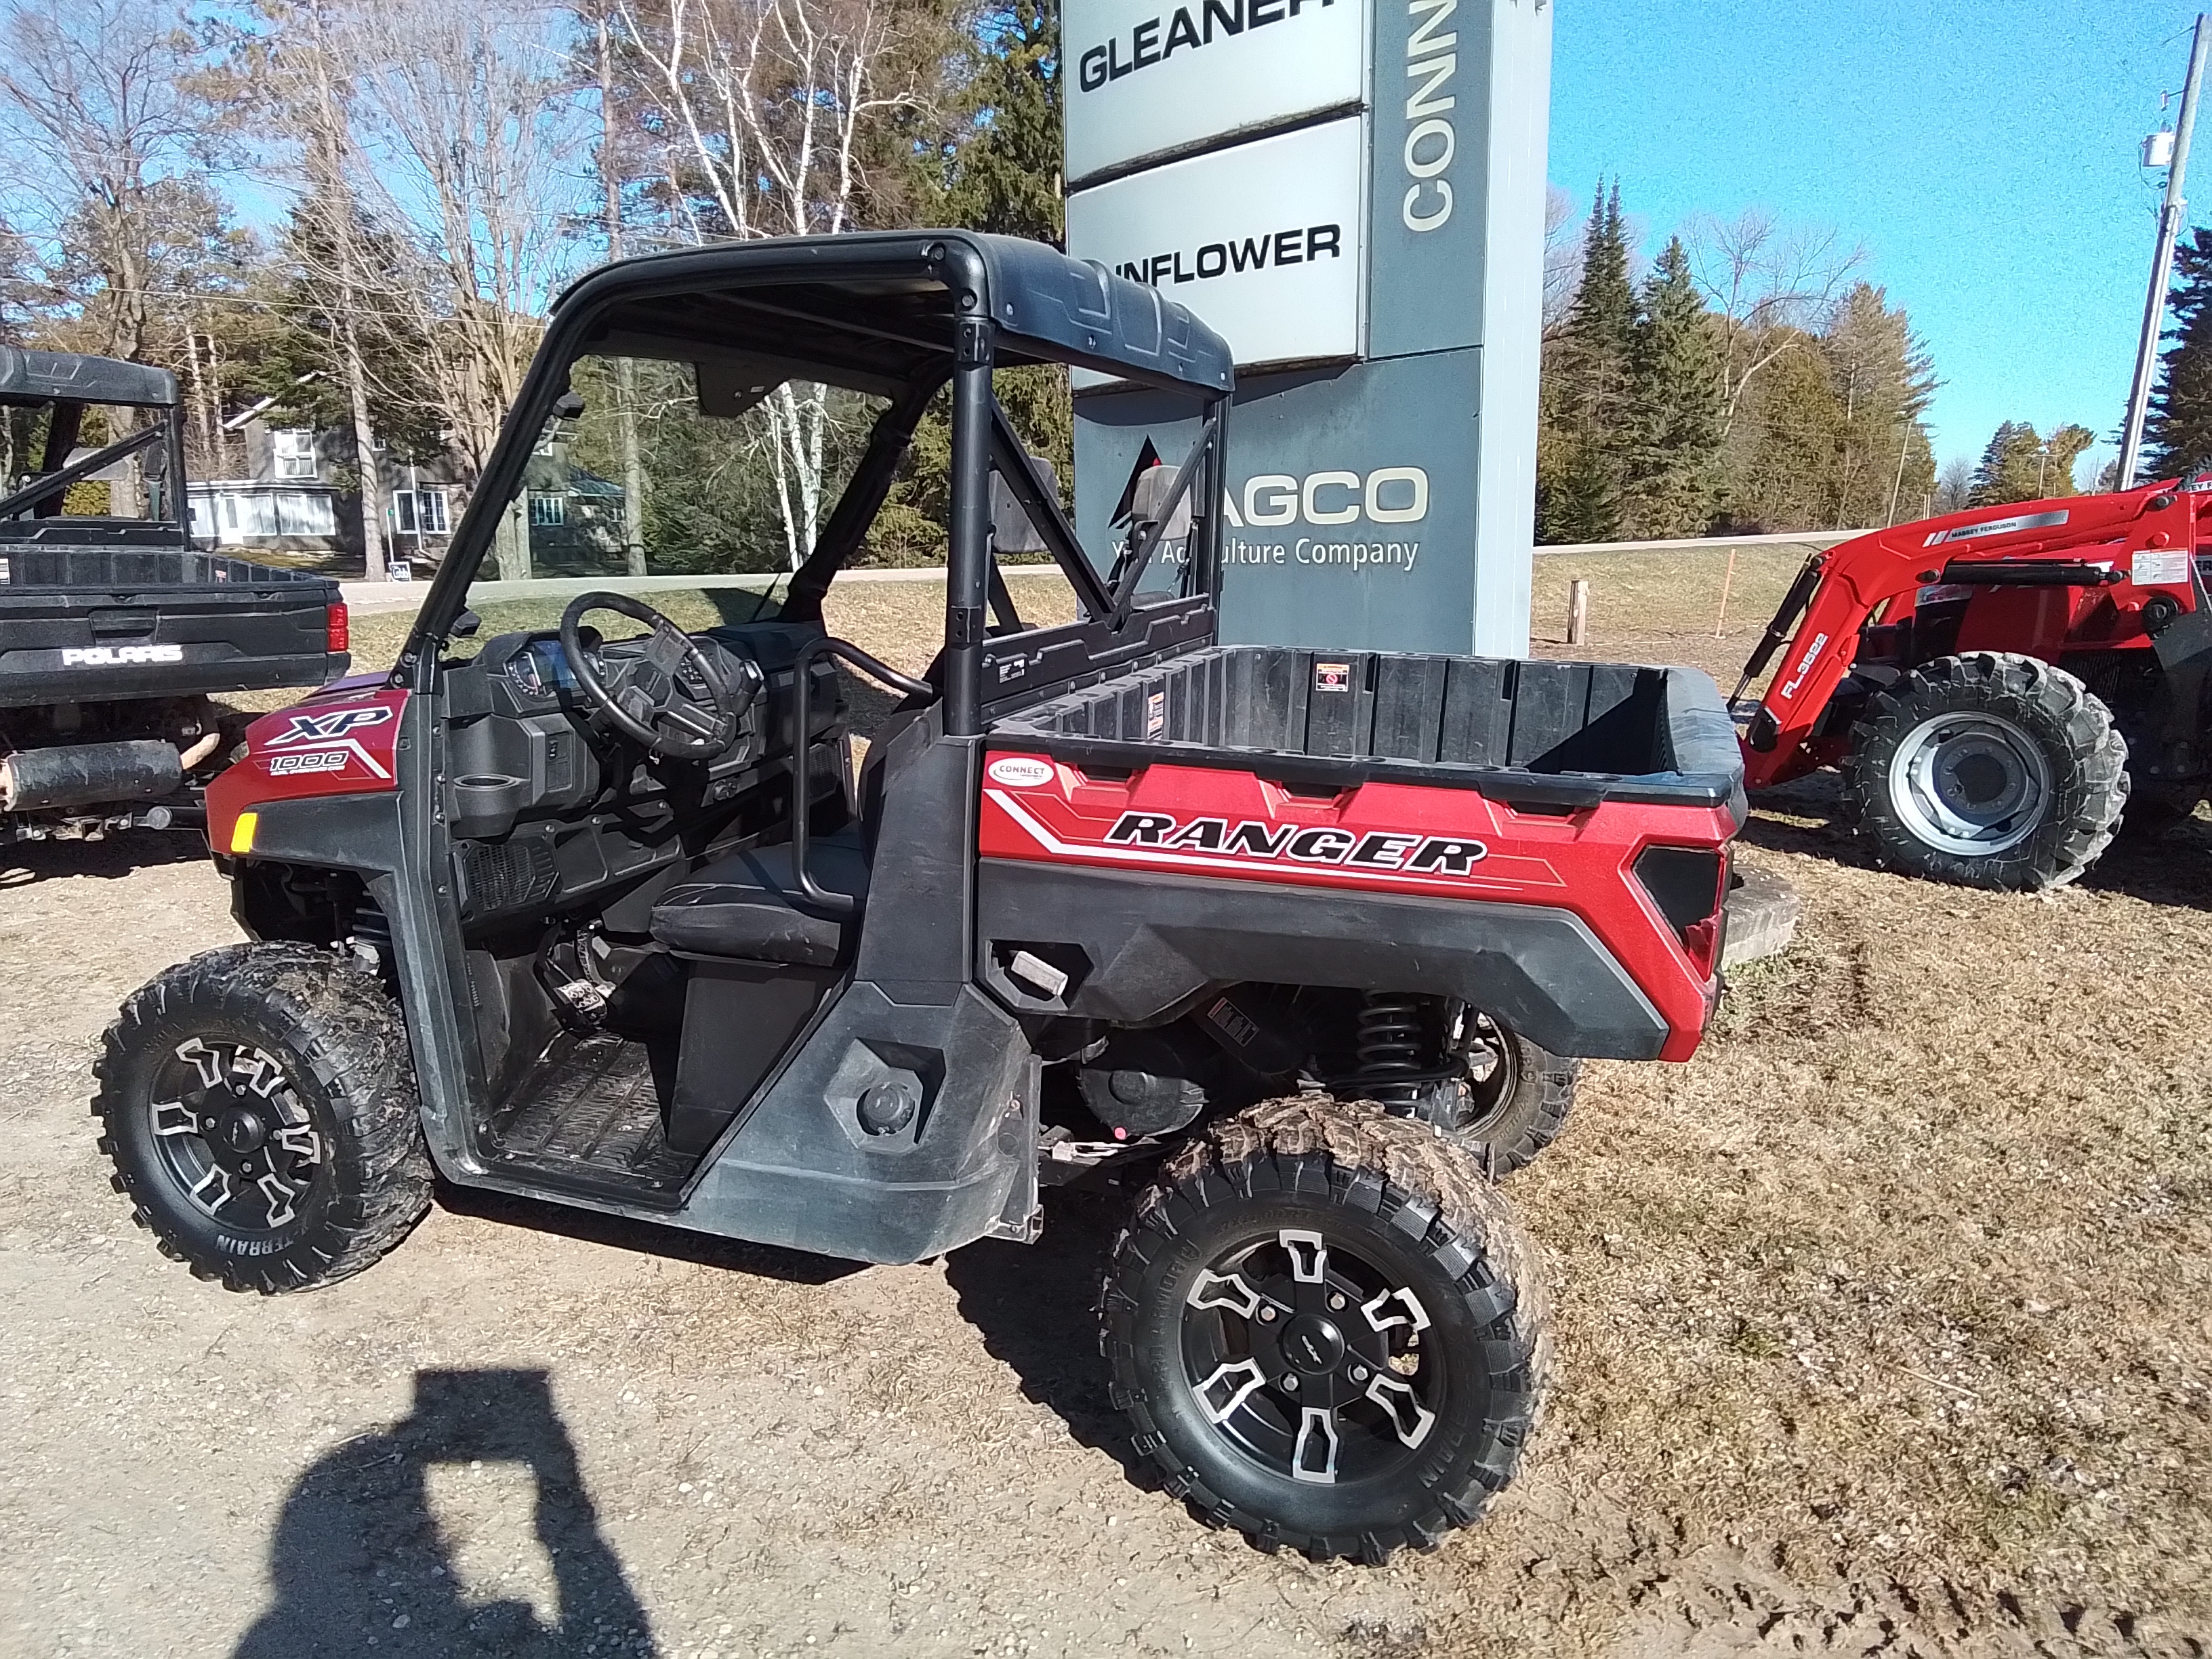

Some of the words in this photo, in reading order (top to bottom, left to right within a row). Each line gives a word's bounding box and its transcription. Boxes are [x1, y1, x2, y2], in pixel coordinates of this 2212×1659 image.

[1115, 224, 1340, 287] NFLOWER
[1951, 528, 1978, 538] MASSEY
[1980, 521, 2017, 533] FERGUSON
[1295, 537, 1419, 571] Company
[62, 644, 183, 665] POLARIS
[264, 706, 393, 745] XP
[270, 751, 349, 771] 1000
[999, 765, 1045, 775] CONNECT
[1103, 811, 1488, 876] RANGER
[216, 1234, 295, 1256] TERRAIN
